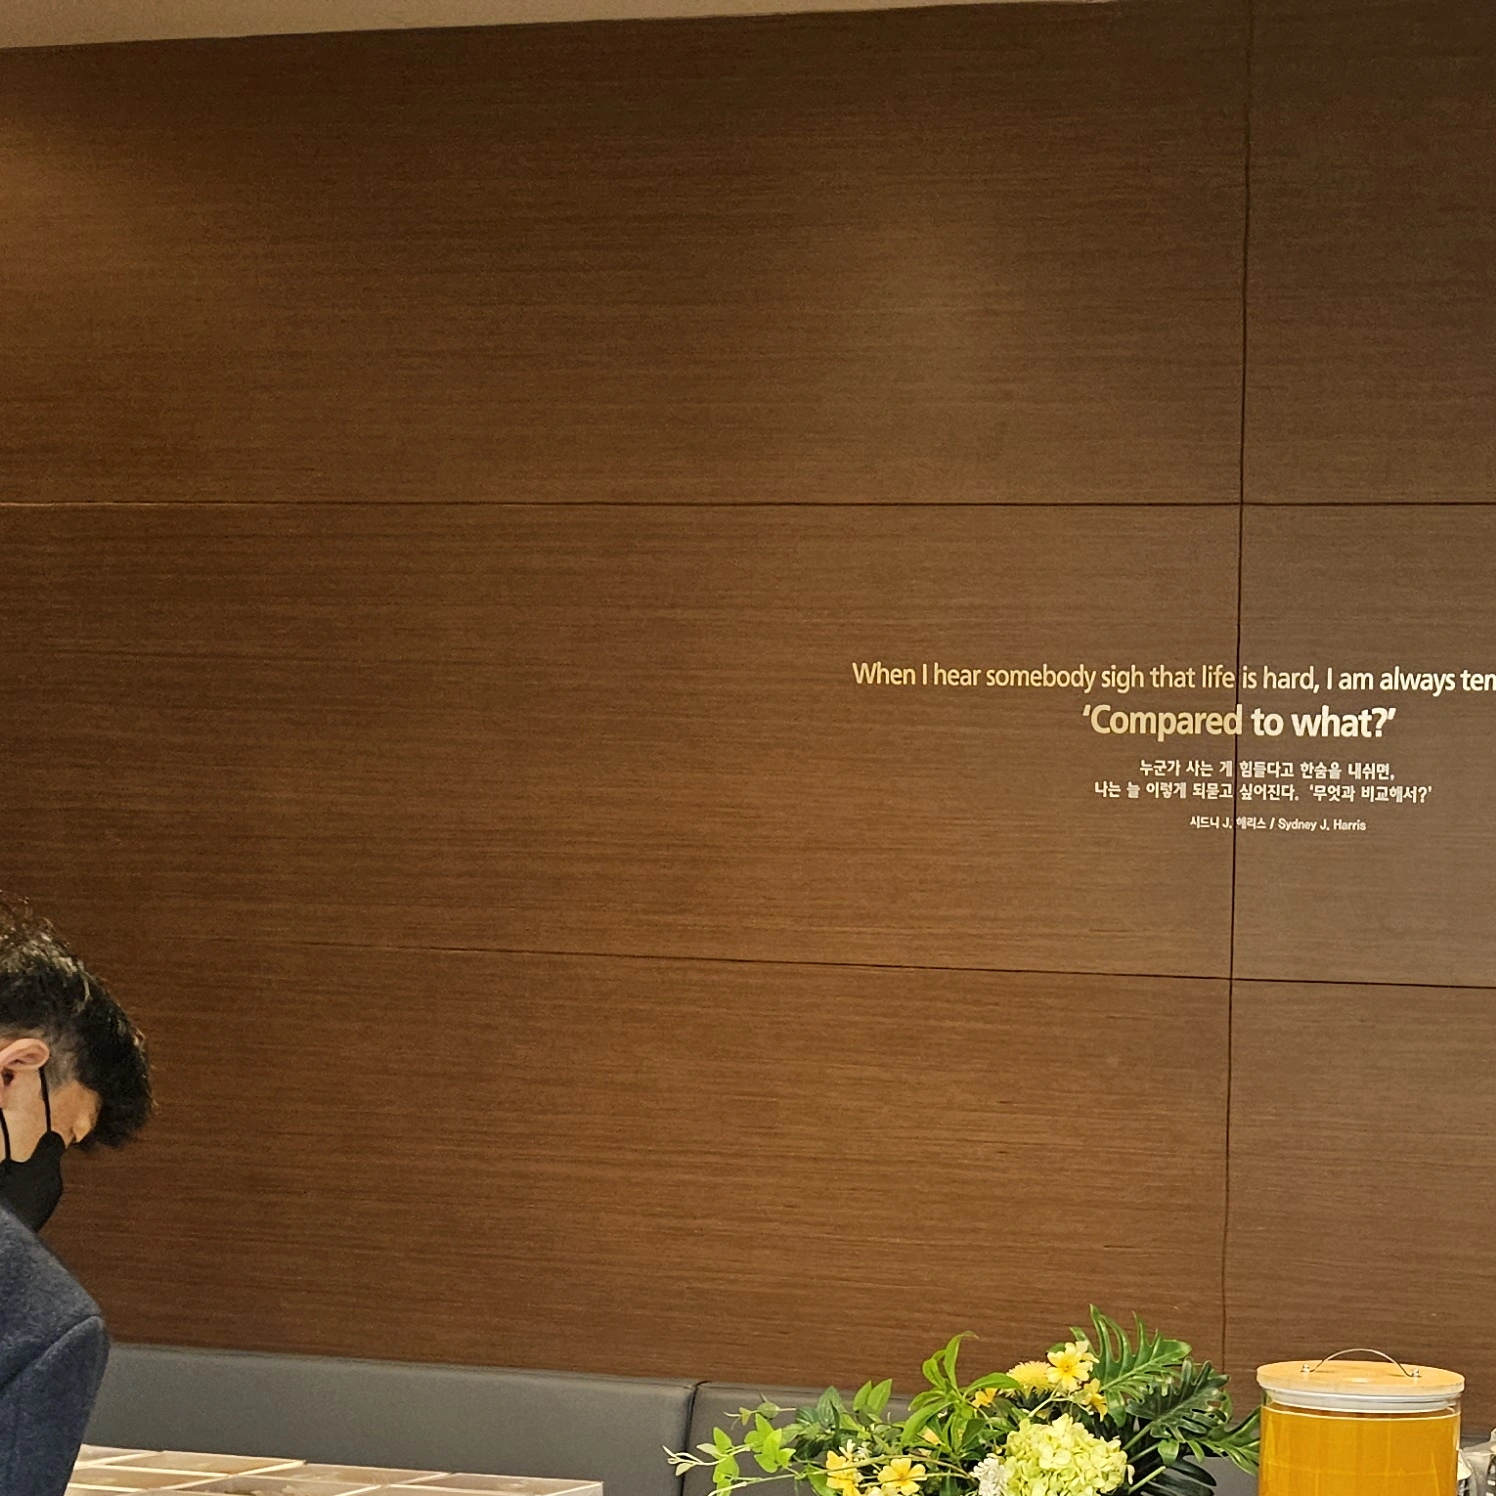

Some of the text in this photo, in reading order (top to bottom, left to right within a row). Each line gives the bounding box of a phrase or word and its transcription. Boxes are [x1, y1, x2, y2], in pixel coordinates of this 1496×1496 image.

[852, 661, 915, 686] When
[922, 663, 928, 686] I
[933, 662, 982, 687] hear
[986, 663, 1097, 694] somebody
[1101, 664, 1145, 694] sigh
[1149, 664, 1196, 689] that
[1202, 664, 1236, 690] life
[1242, 665, 1258, 690] is
[1262, 665, 1320, 694] hard,
[1326, 667, 1333, 691] I
[1338, 672, 1374, 691] am
[1379, 666, 1456, 698] always
[1250, 707, 1285, 737] to
[1139, 759, 1395, 782] 누군가 사는 게 힘들다고 한숨을 내쉬면,
[1094, 781, 1122, 798] 나는
[1126, 781, 1141, 799] 늘
[1145, 781, 1187, 799] 이렇게
[1239, 782, 1300, 802] 싶어진다.
[1189, 815, 1220, 829] 시드니
[1221, 816, 1233, 830] J.
[1277, 817, 1318, 832] Sydney
[1319, 818, 1331, 831] J.
[1333, 818, 1367, 831] Harris
